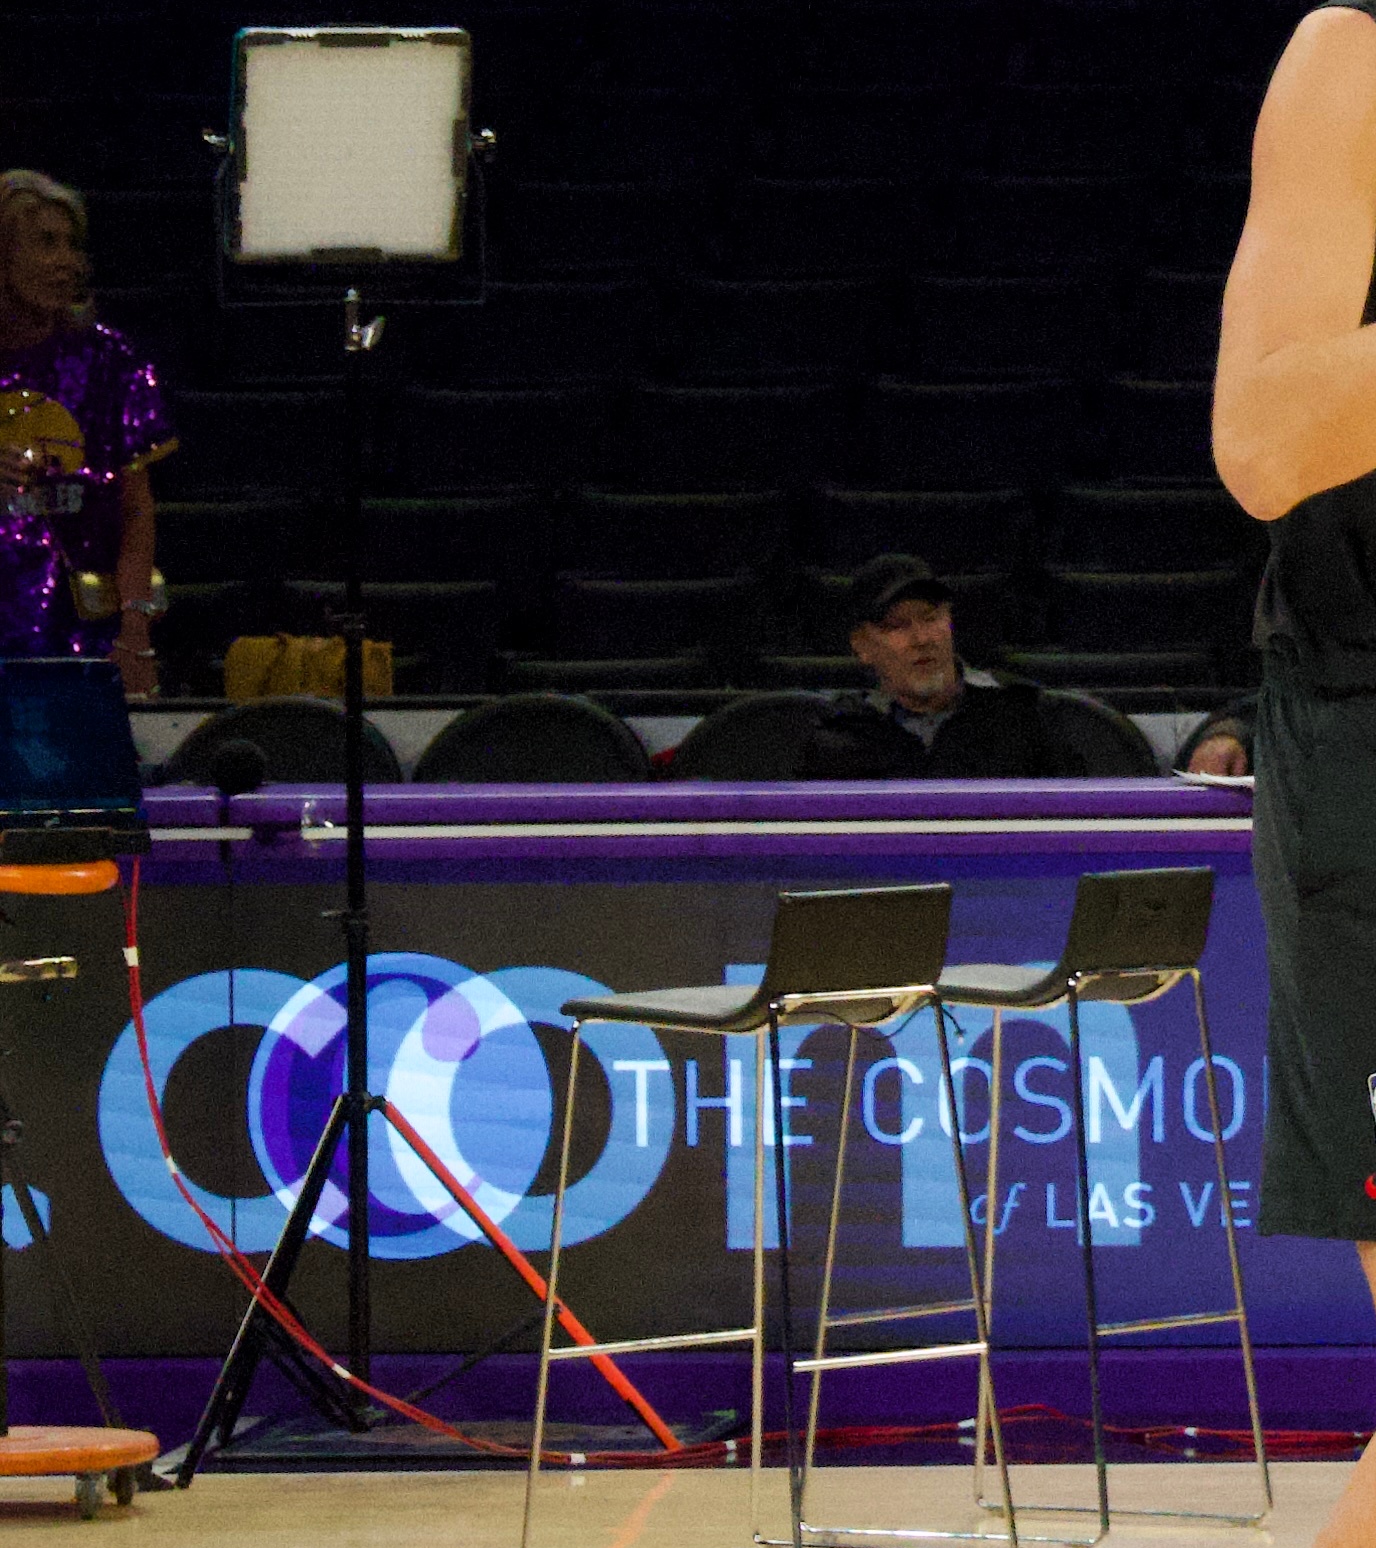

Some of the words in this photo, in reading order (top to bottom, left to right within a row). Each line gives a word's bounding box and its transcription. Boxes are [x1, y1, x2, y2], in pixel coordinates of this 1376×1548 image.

[613, 1059, 814, 1147] THE
[862, 1055, 1268, 1146] COSMO
[1046, 1181, 1156, 1229] LAS
[1179, 1180, 1252, 1227] VE
